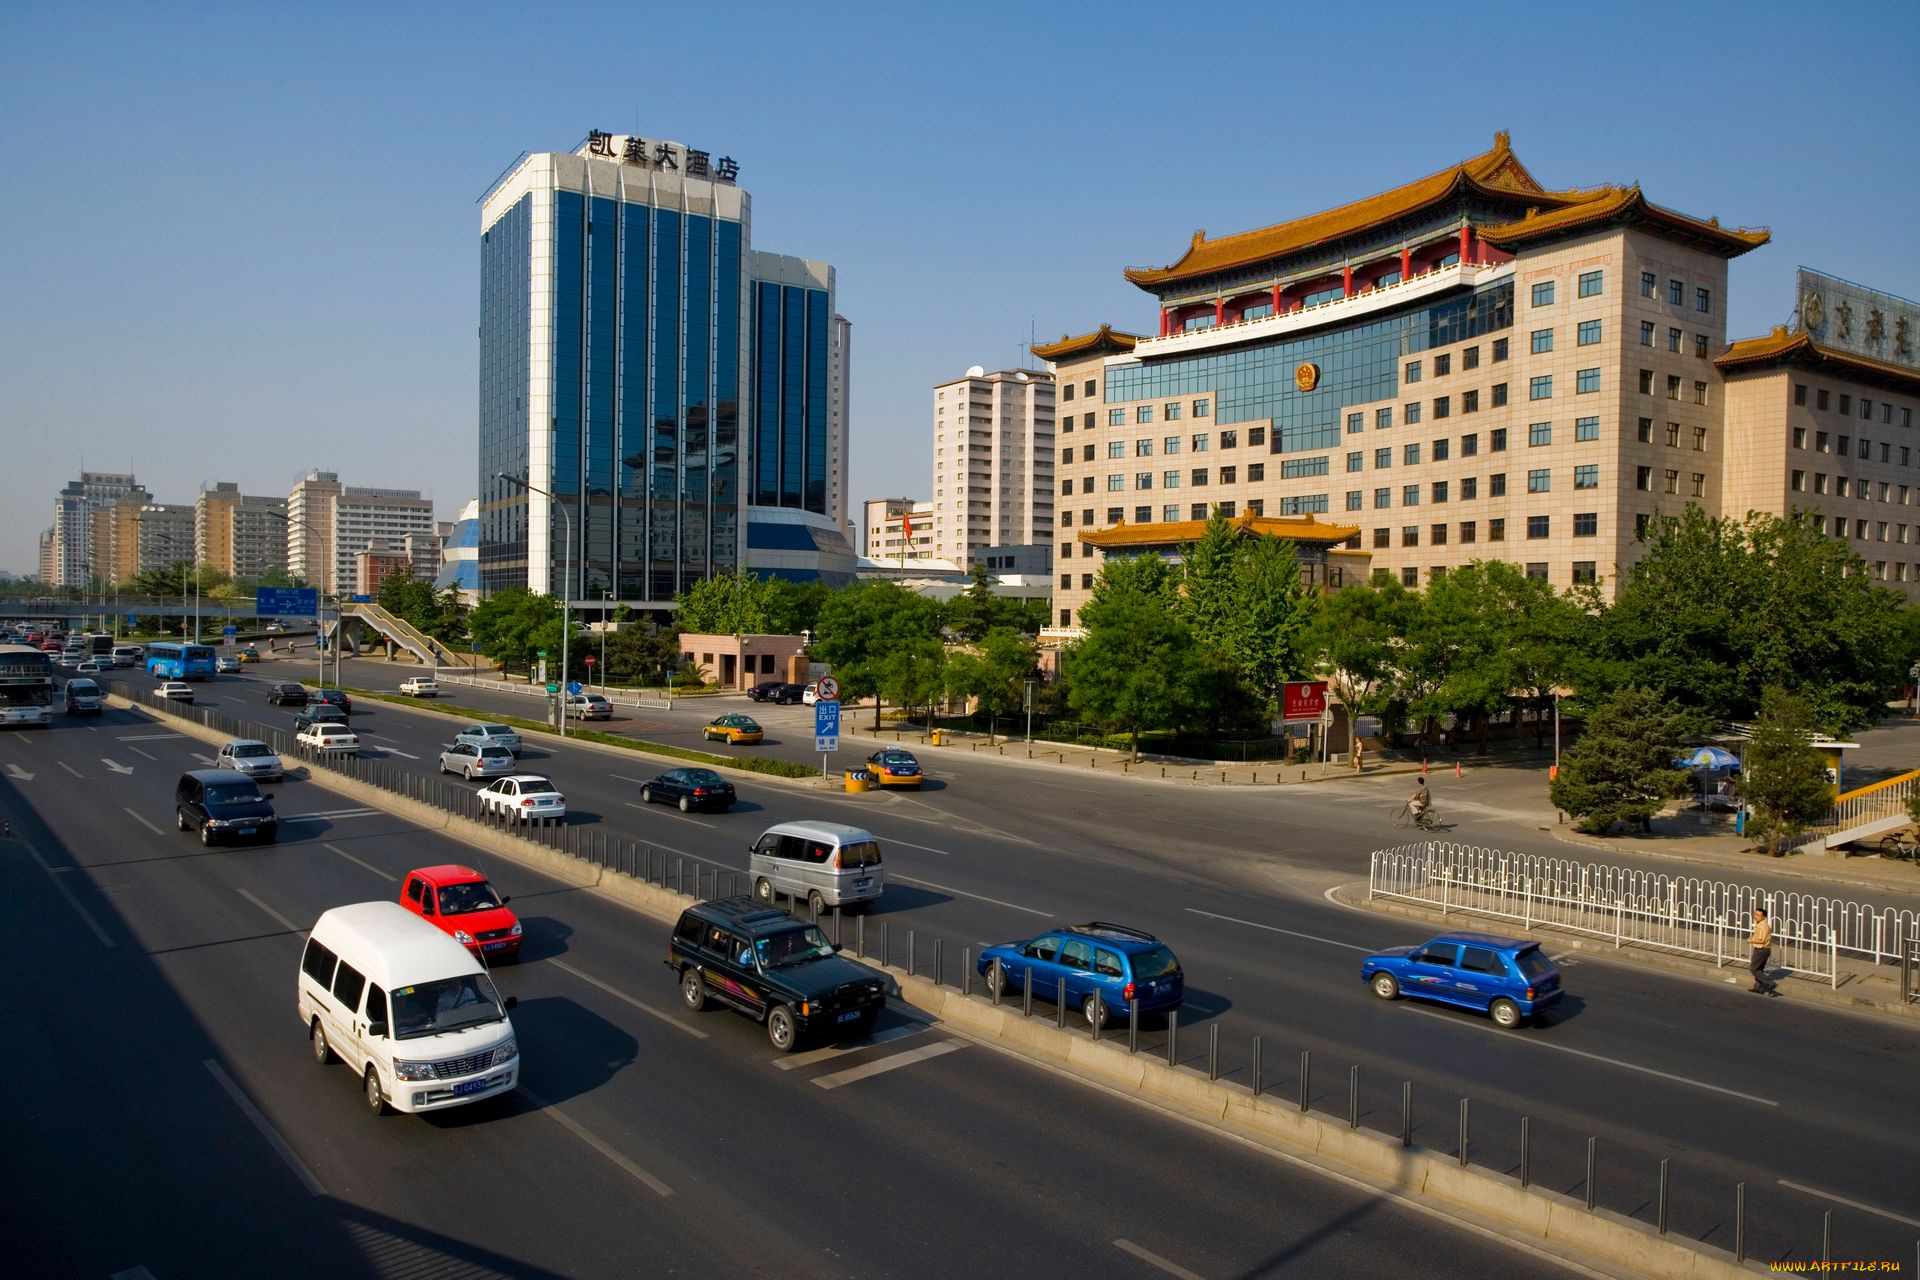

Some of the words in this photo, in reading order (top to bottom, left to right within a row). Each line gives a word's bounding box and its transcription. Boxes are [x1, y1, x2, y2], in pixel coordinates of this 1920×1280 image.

[587, 128, 740, 181] 凯莱大酒店
[819, 705, 836, 715] 出口
